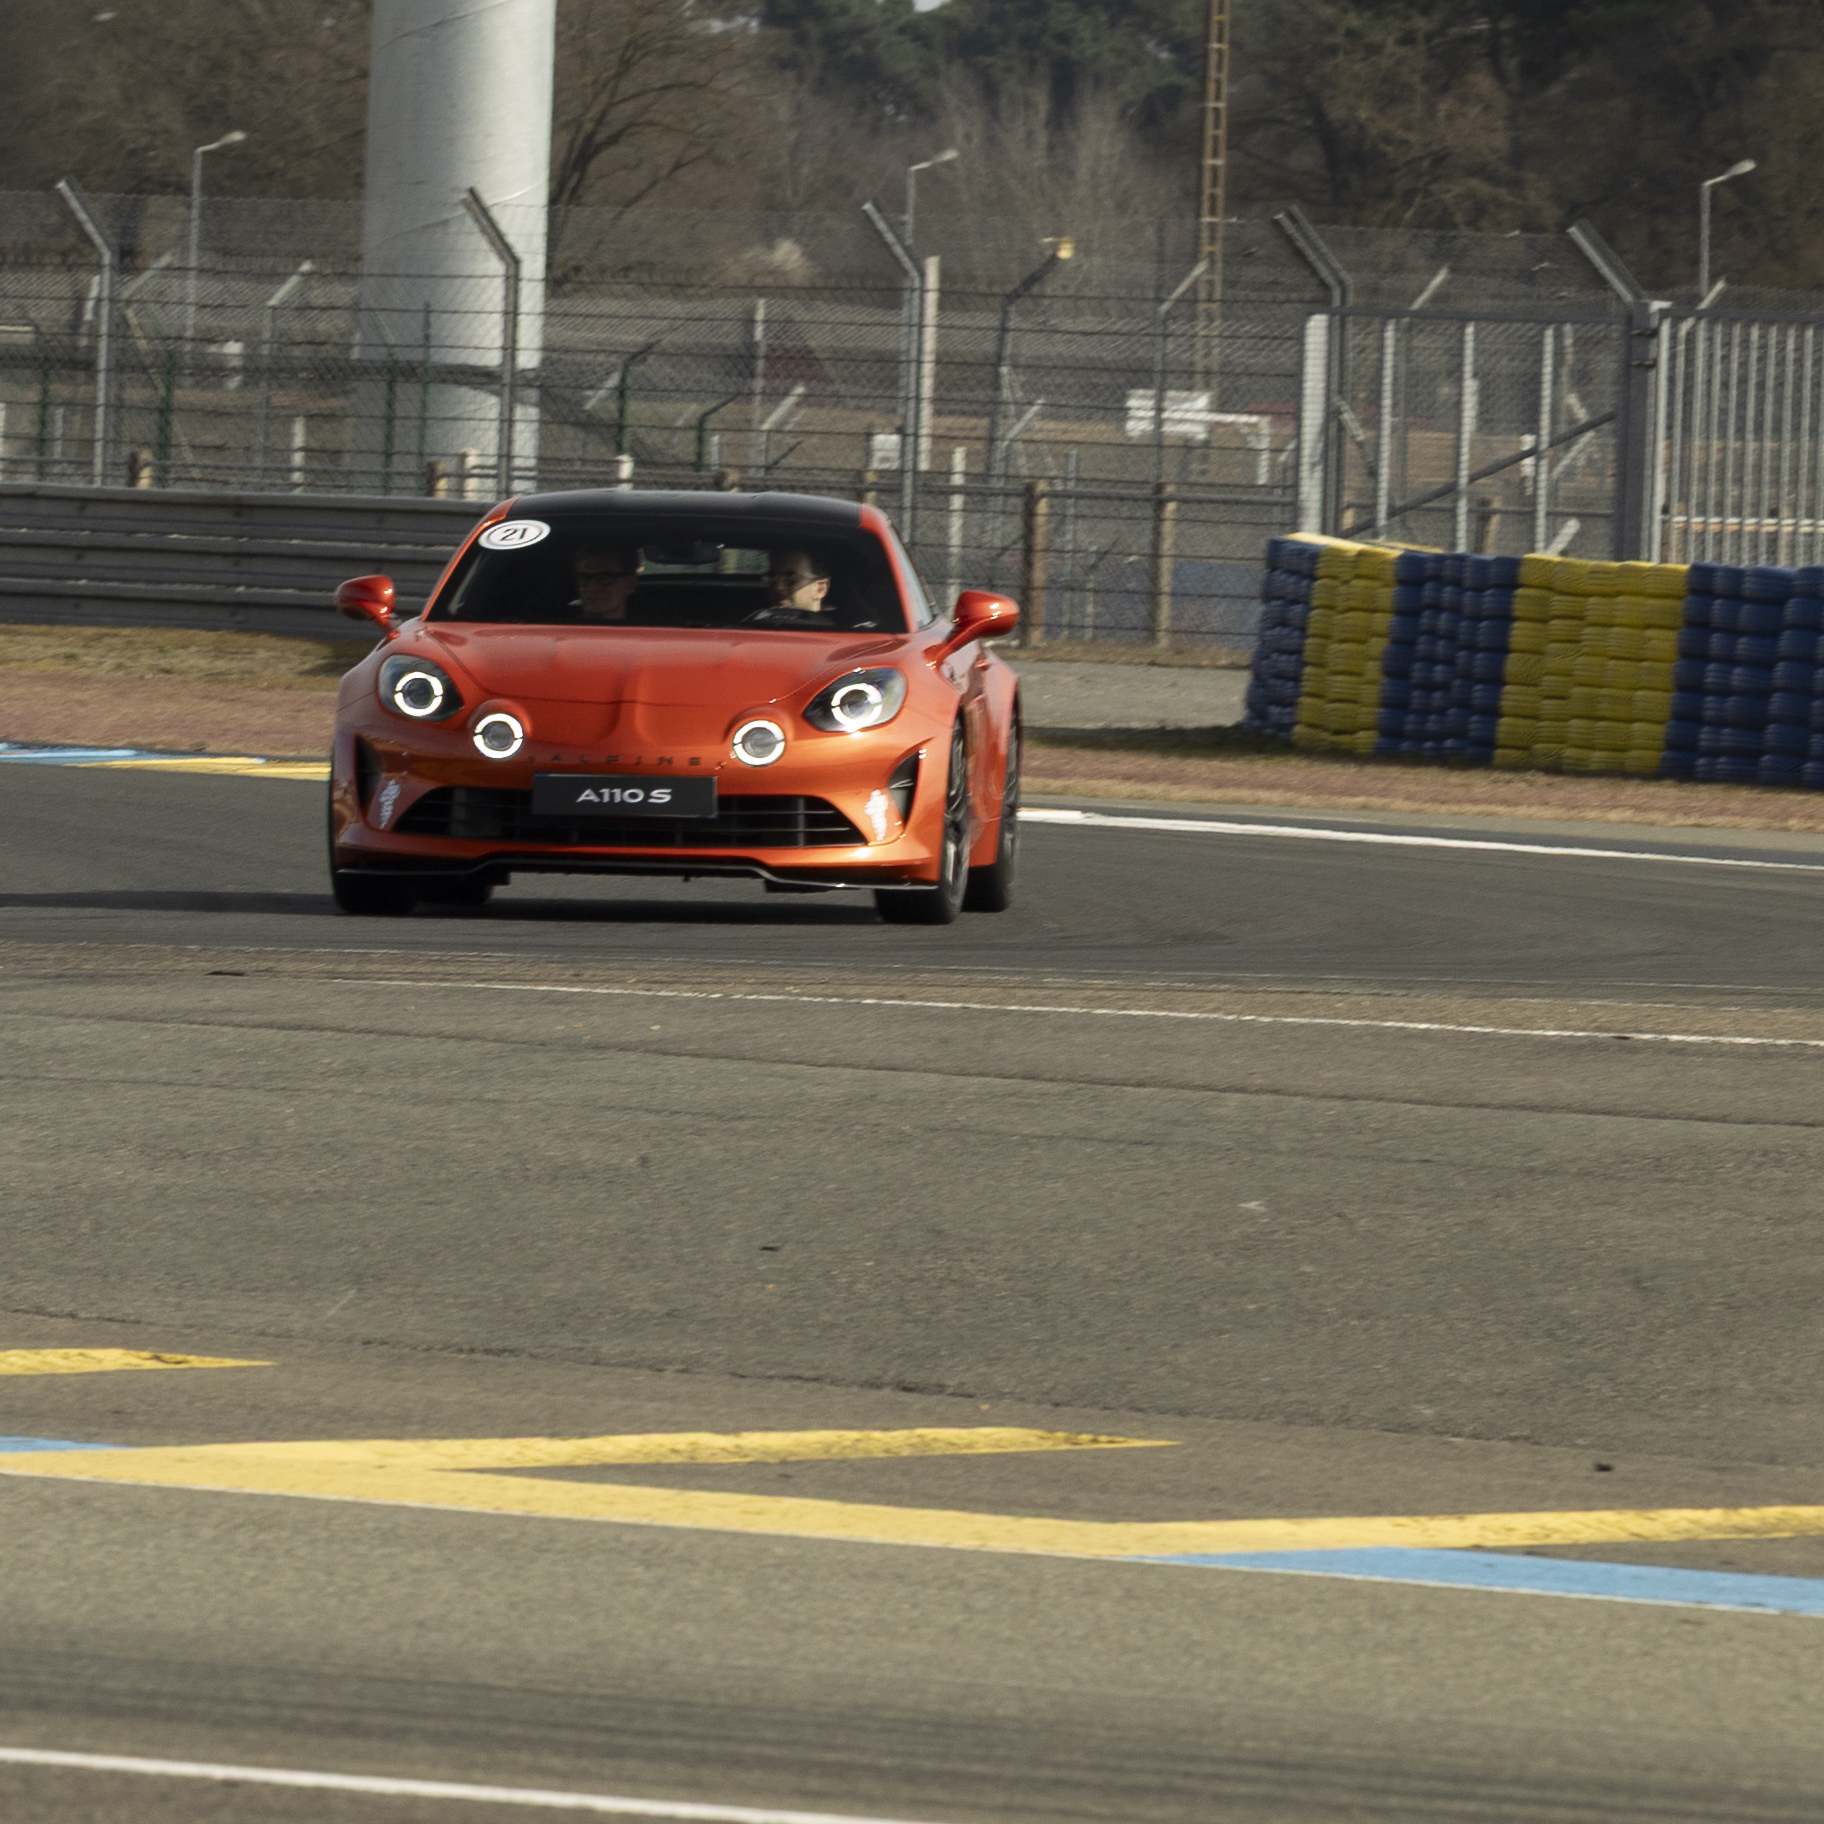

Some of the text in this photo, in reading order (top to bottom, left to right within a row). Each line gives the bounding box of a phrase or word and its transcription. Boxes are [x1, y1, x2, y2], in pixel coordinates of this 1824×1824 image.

[499, 526, 529, 542] 21
[552, 753, 703, 766] ALPINE
[575, 787, 645, 804] A110
